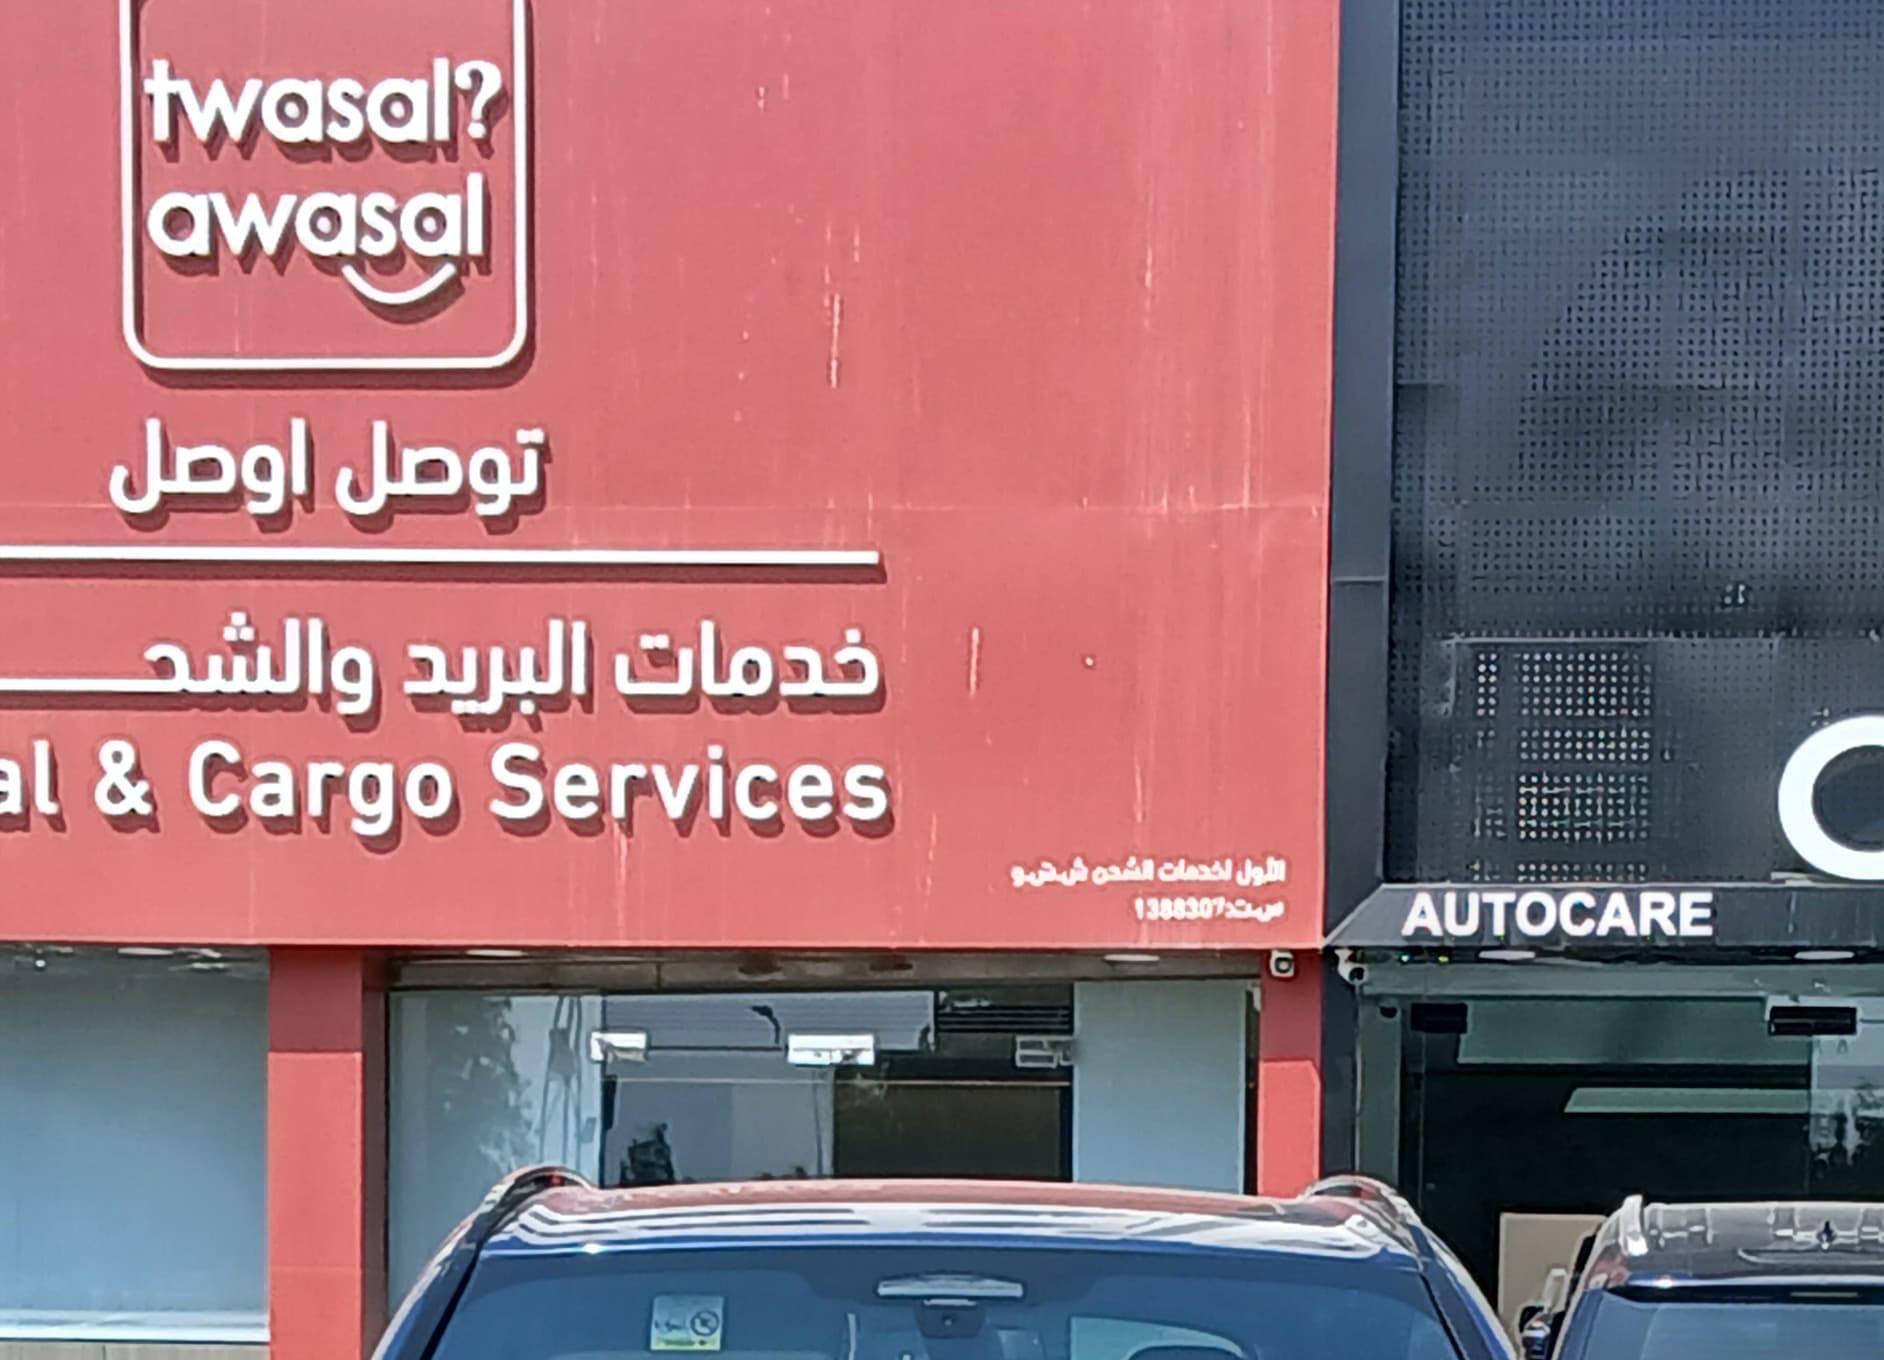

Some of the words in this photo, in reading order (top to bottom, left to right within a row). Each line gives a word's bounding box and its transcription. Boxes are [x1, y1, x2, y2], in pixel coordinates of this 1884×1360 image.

[143, 57, 503, 143] twasal?
[147, 172, 484, 258] awasal
[109, 418, 306, 514] اوصل
[335, 421, 545, 516] توصل
[403, 620, 587, 715] البريد
[615, 620, 880, 697] خدمات
[94, 739, 153, 816] &
[188, 740, 453, 836] Cargo
[489, 742, 888, 821] Services
[1401, 891, 1714, 938] AUTOCARE
